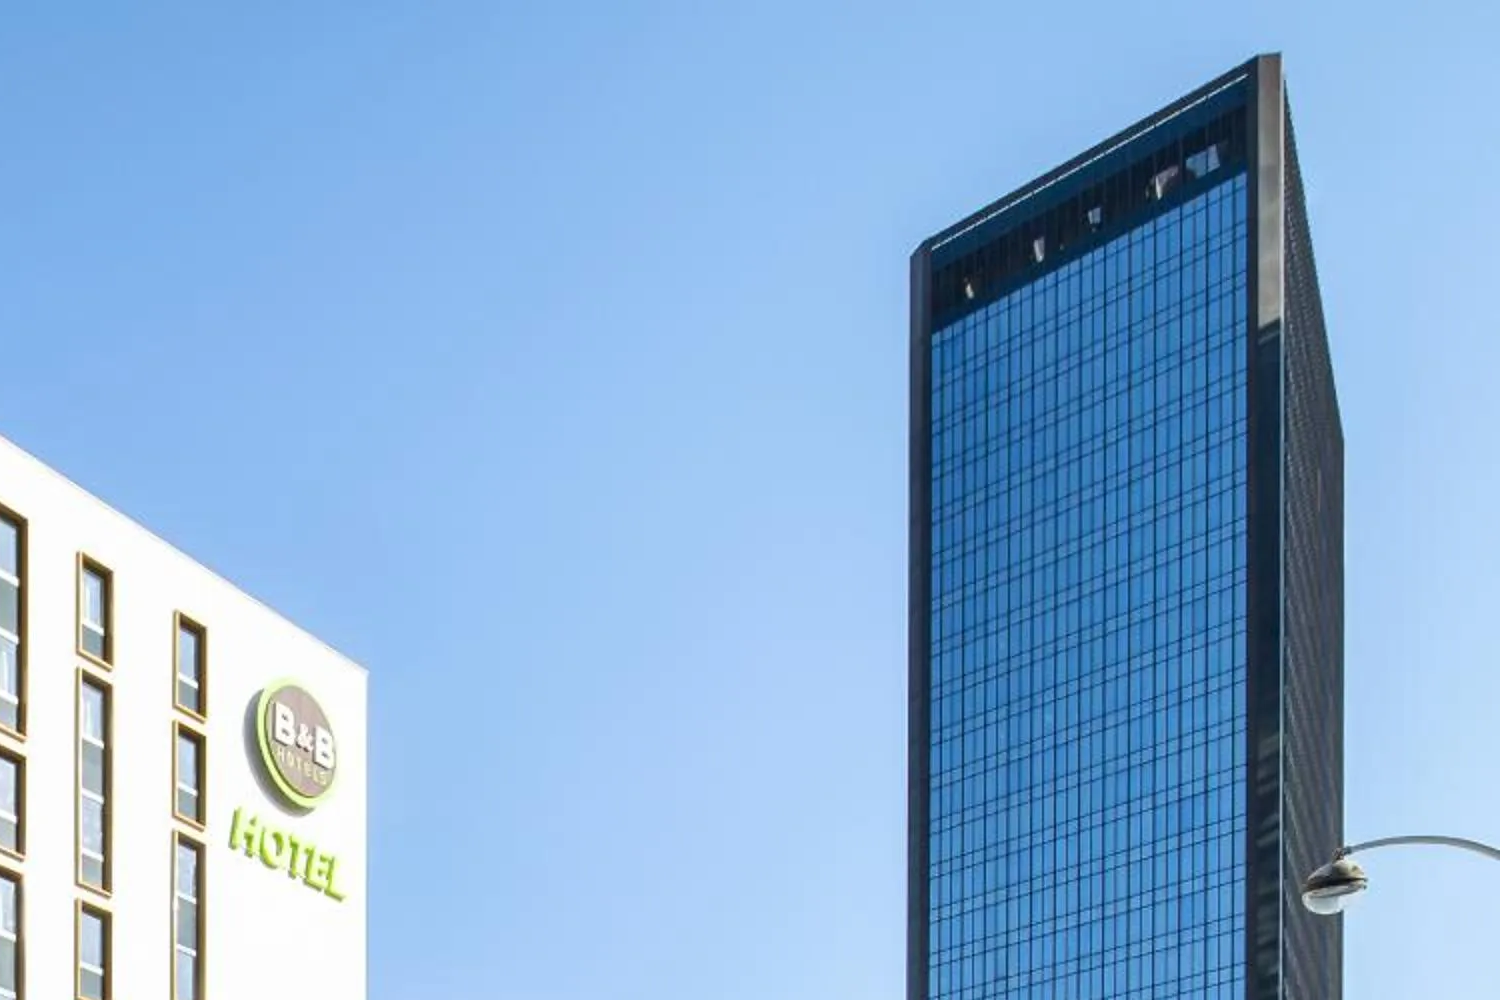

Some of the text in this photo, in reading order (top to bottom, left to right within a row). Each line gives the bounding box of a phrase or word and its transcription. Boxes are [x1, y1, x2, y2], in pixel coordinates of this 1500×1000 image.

[273, 702, 336, 769] B&B
[277, 745, 328, 786] HOTELS
[228, 806, 346, 901] HOTEL
